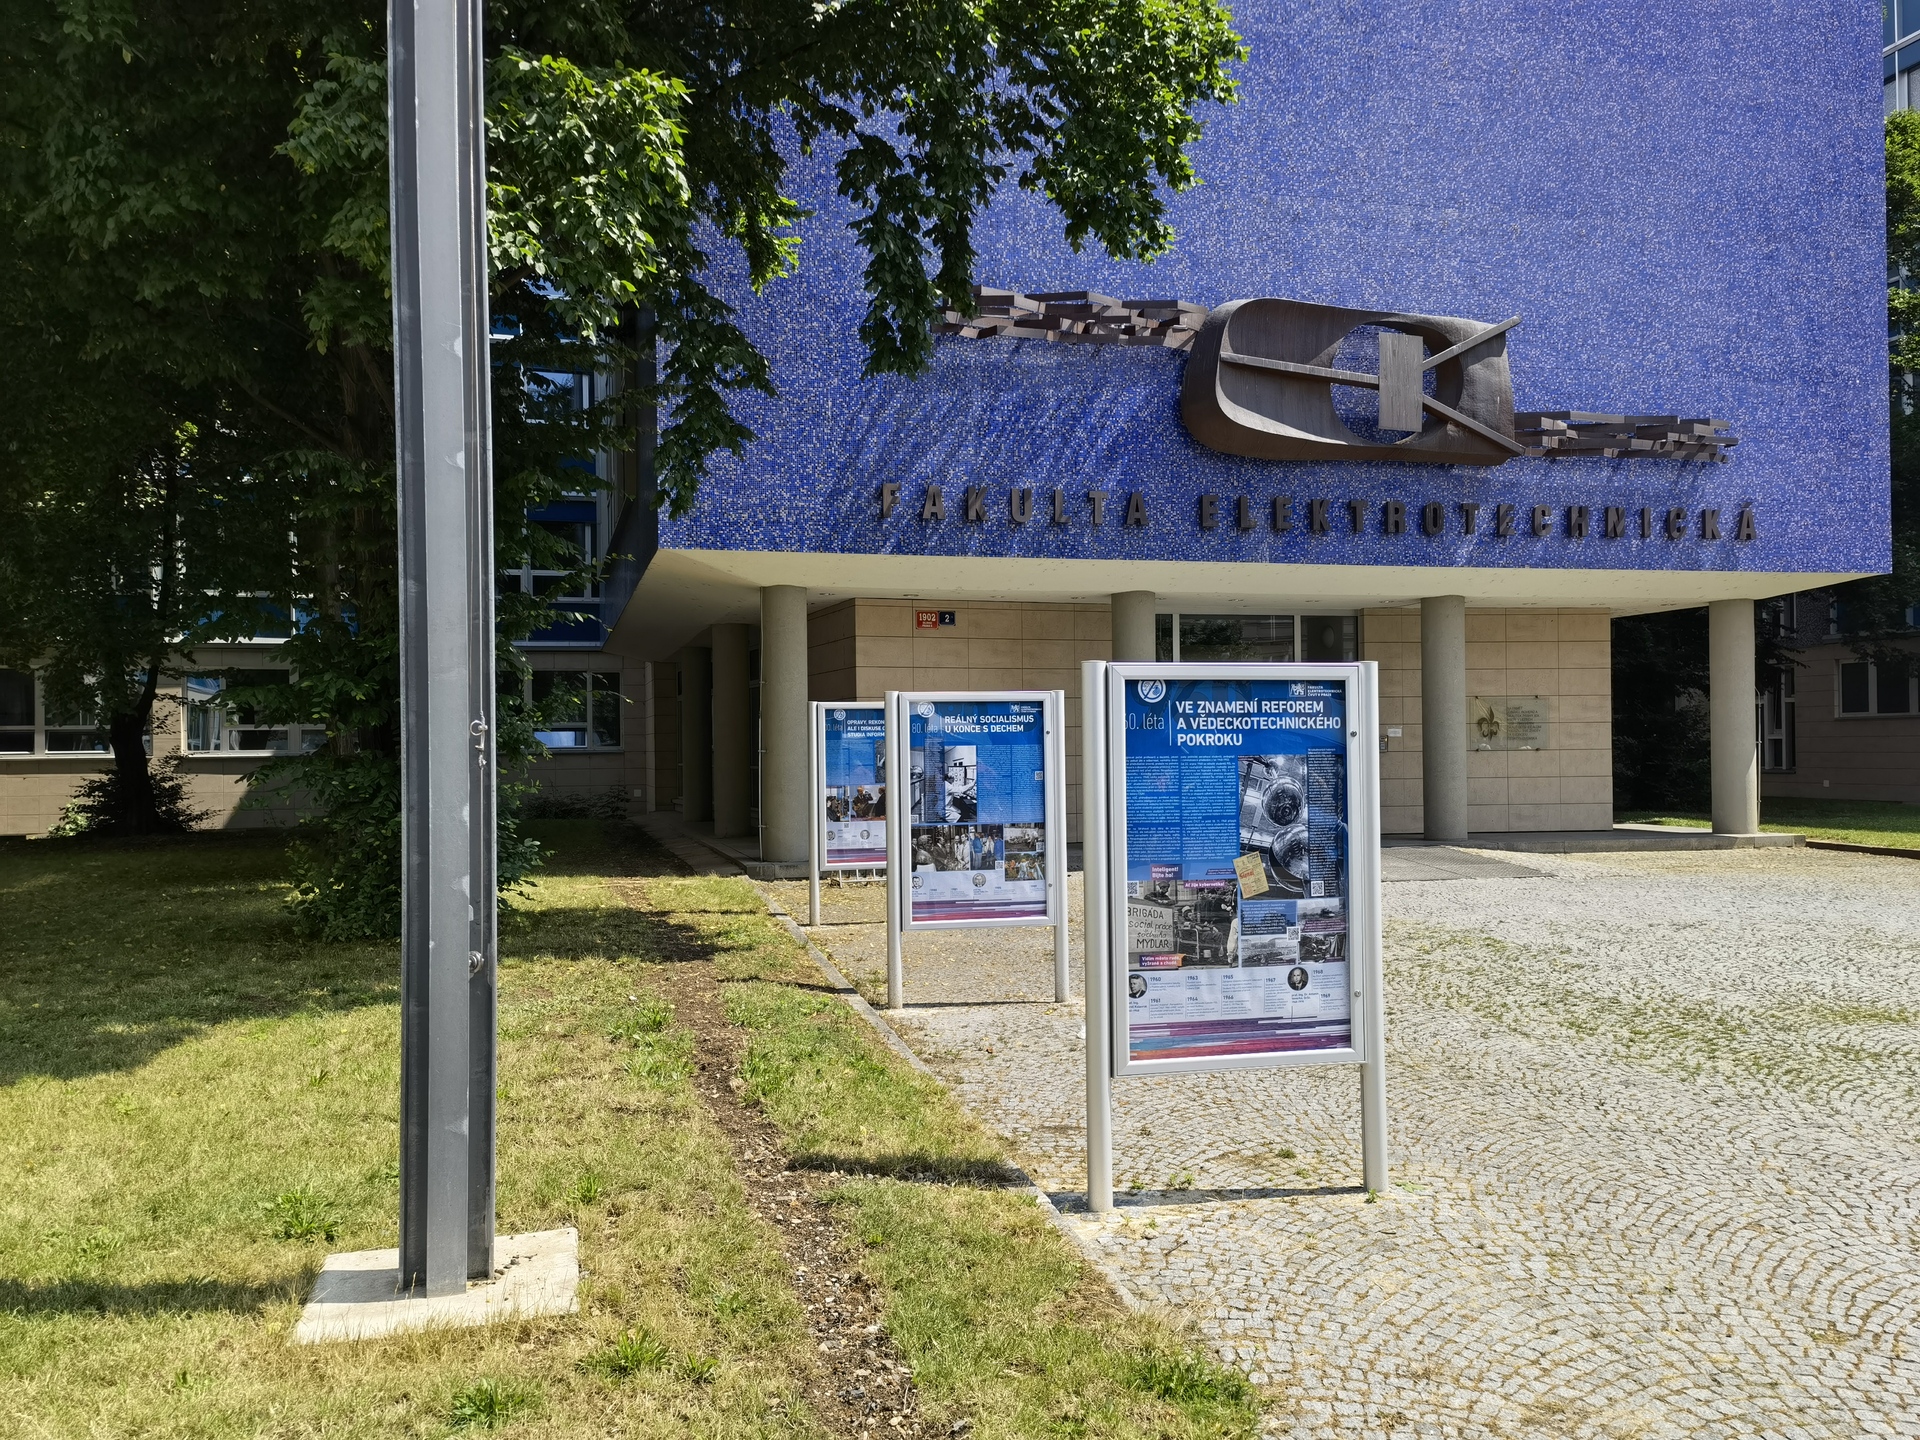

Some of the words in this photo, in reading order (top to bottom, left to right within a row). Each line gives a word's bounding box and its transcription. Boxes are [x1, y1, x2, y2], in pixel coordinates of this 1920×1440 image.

[881, 482, 1149, 526] FAKULTA
[1202, 494, 1757, 541] ELEKTROTECHNICKÁ
[919, 613, 936, 622] 1902
[944, 614, 950, 622] 2
[1176, 701, 1193, 714] VE
[1197, 698, 1258, 714] ZNAMENÍ
[1262, 701, 1324, 713] REFOREM
[944, 714, 978, 724] REÁLNÝ
[980, 714, 1034, 723] SOCIALISMUS
[1143, 713, 1165, 730] léta
[1177, 718, 1187, 730] A
[1190, 714, 1341, 730] VĚDECKOTECHNICKÉHO
[911, 723, 922, 734] 80.
[925, 723, 939, 733] léta
[945, 725, 951, 733] U
[953, 725, 981, 733] KONCE
[982, 725, 989, 733] S
[990, 725, 1024, 733] DECHEM
[1177, 733, 1243, 746] POKROKU
